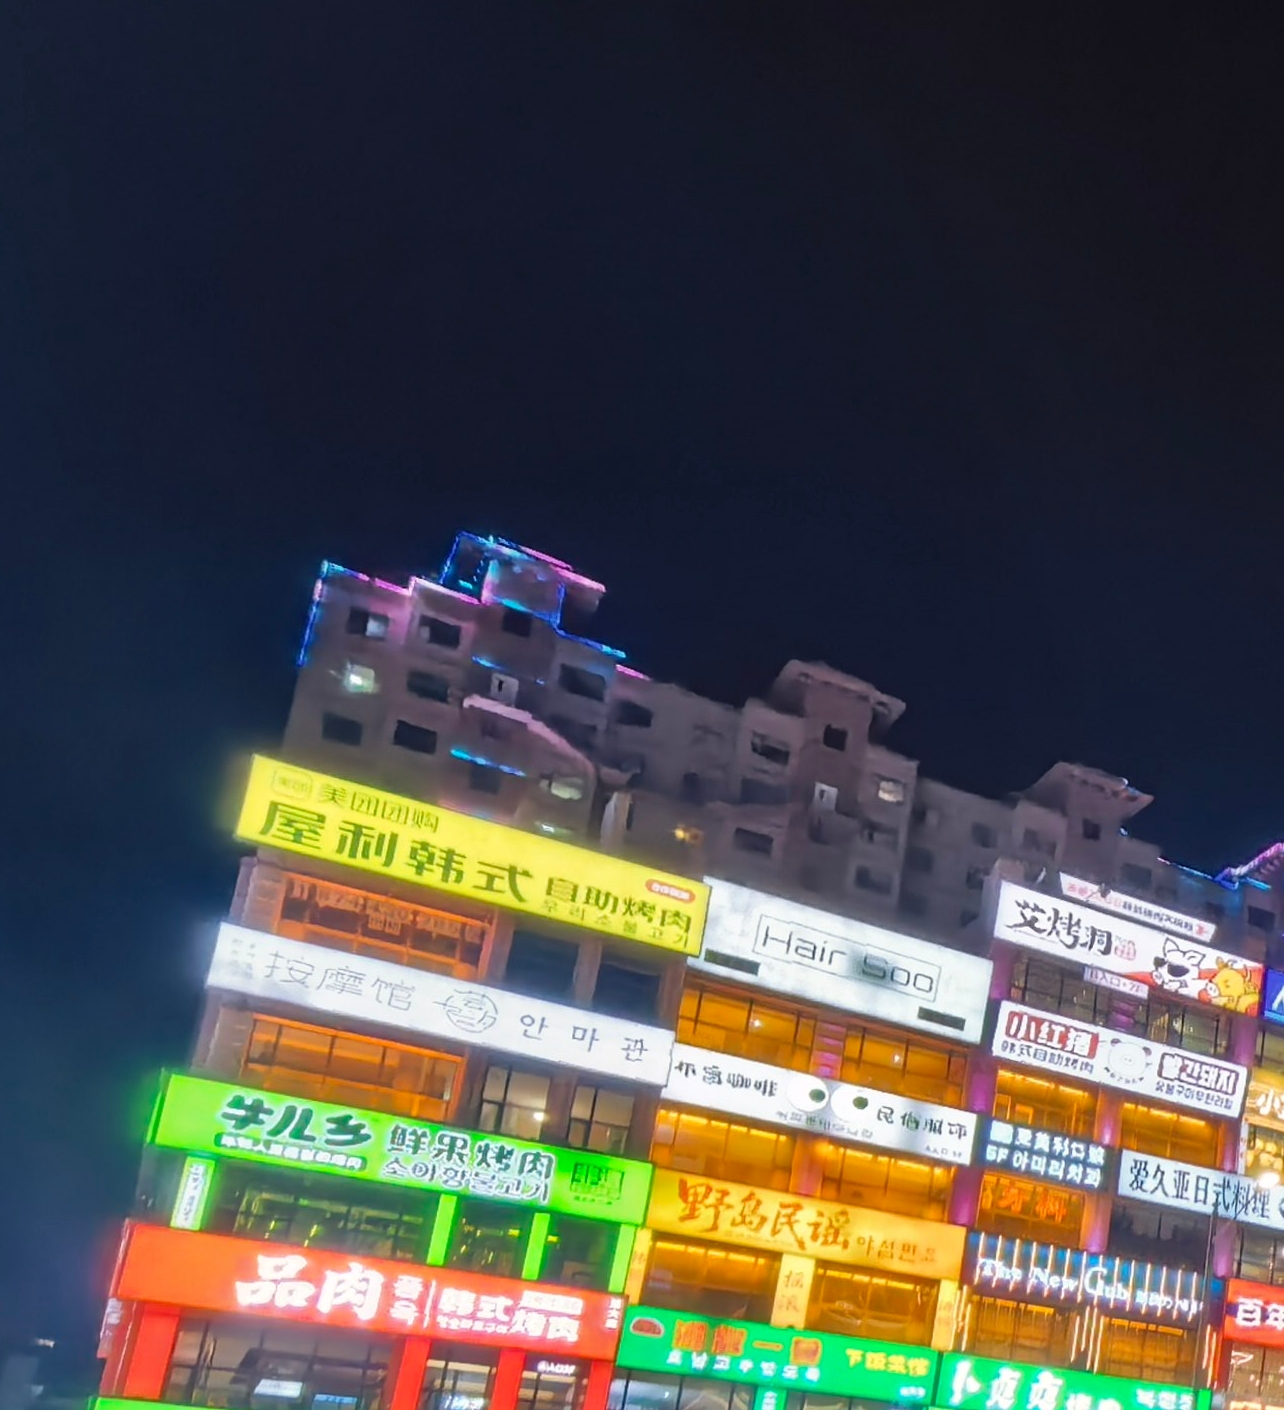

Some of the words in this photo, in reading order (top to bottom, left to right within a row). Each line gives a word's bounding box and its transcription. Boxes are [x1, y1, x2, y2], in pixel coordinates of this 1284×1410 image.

[321, 783, 439, 833] 美团团购
[259, 800, 533, 903] 屋利韩式
[545, 876, 693, 934] 自助烤肉
[264, 950, 417, 1011] 按摩馆
[762, 926, 847, 966] Hair
[861, 951, 935, 994] Soo
[520, 1013, 649, 1063] 안마관
[390, 1123, 555, 1180] 鲜果烤肉
[679, 1177, 850, 1251] 野岛民谣
[234, 1254, 385, 1322] 品肉
[979, 1258, 1023, 1281] The
[1031, 1266, 1079, 1292] New
